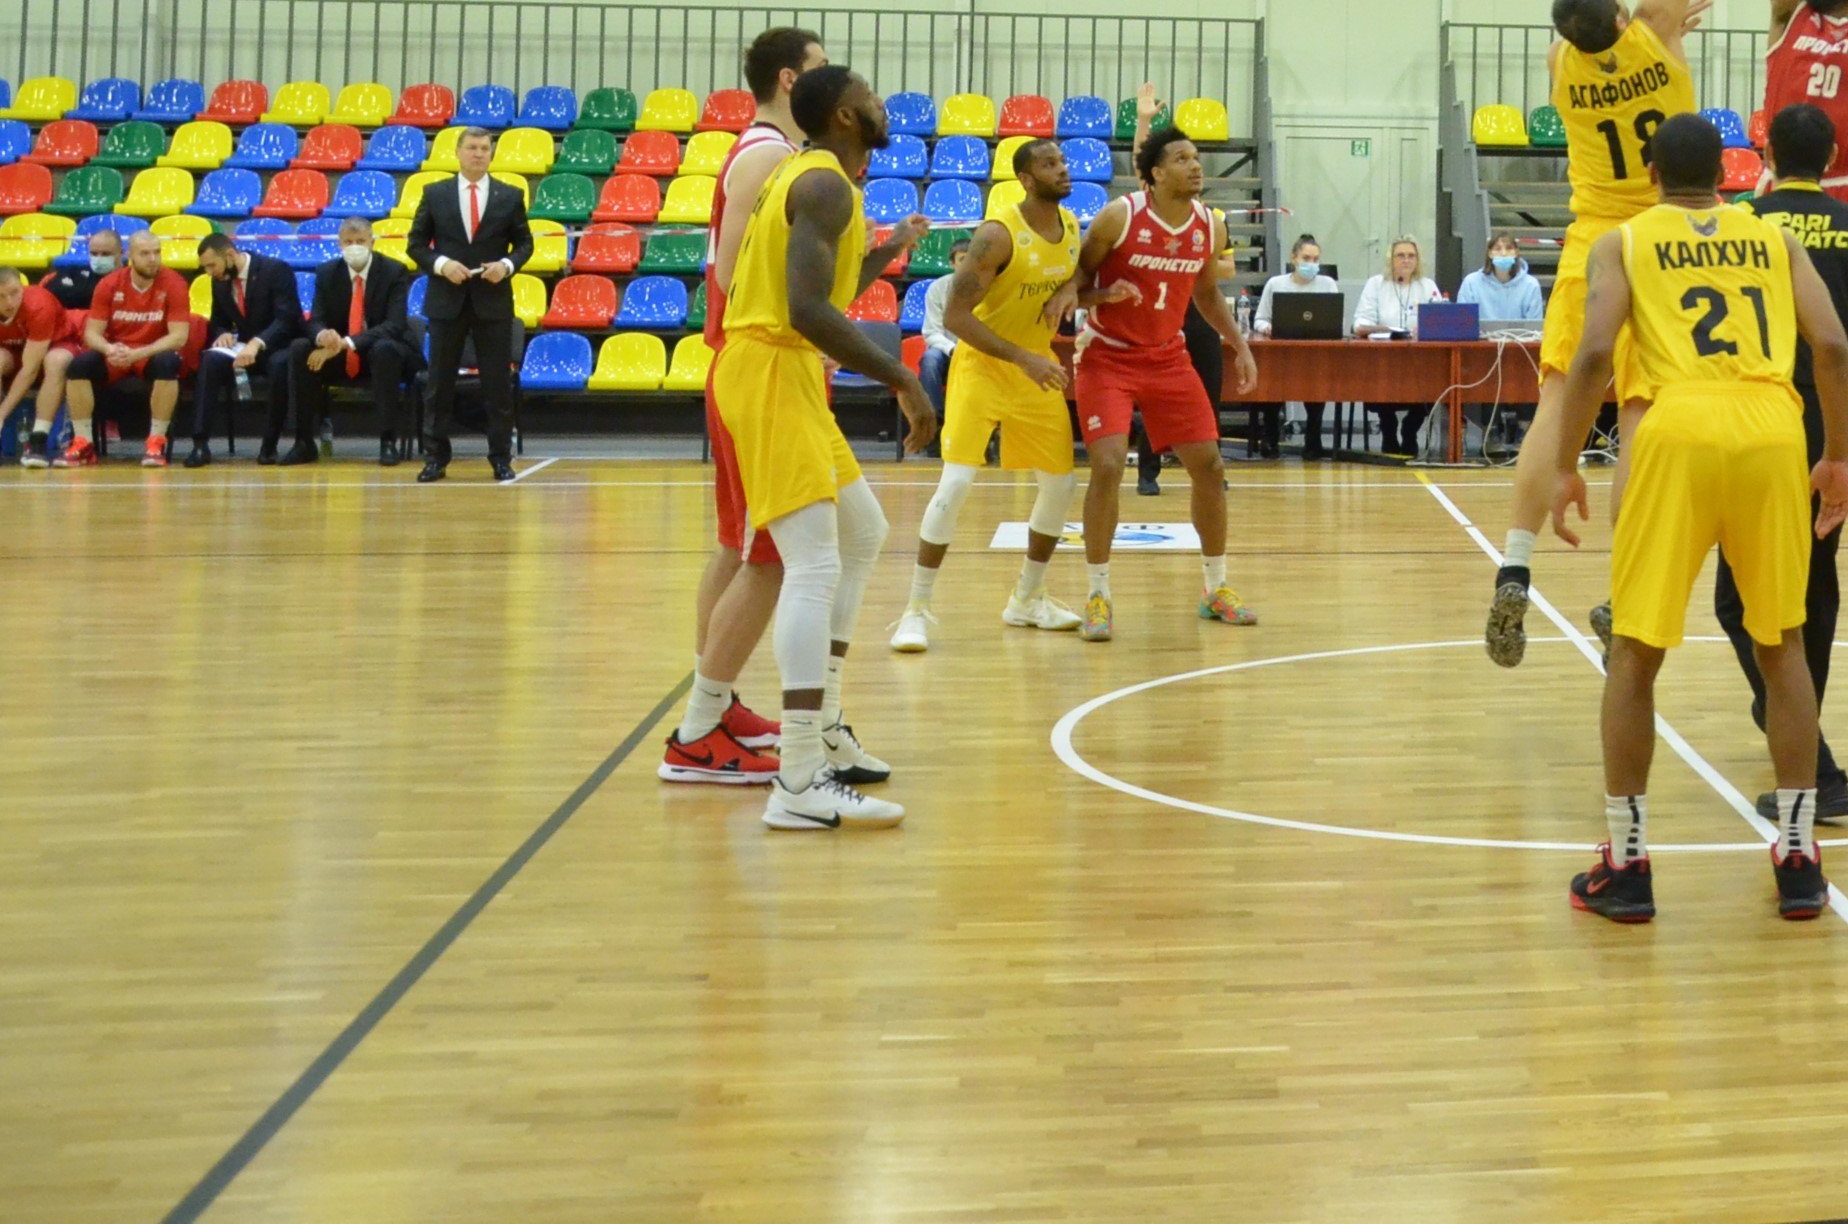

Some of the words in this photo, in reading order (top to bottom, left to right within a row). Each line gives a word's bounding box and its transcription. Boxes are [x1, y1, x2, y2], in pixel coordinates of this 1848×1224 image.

[1569, 61, 1670, 109] АГАФОНОВ
[1807, 62, 1842, 99] 20
[1128, 254, 1205, 274] ПРОМЕТЕЙ
[1654, 239, 1770, 271] КАЛХУН
[1154, 282, 1168, 310] 1
[1681, 286, 1772, 362] 21
